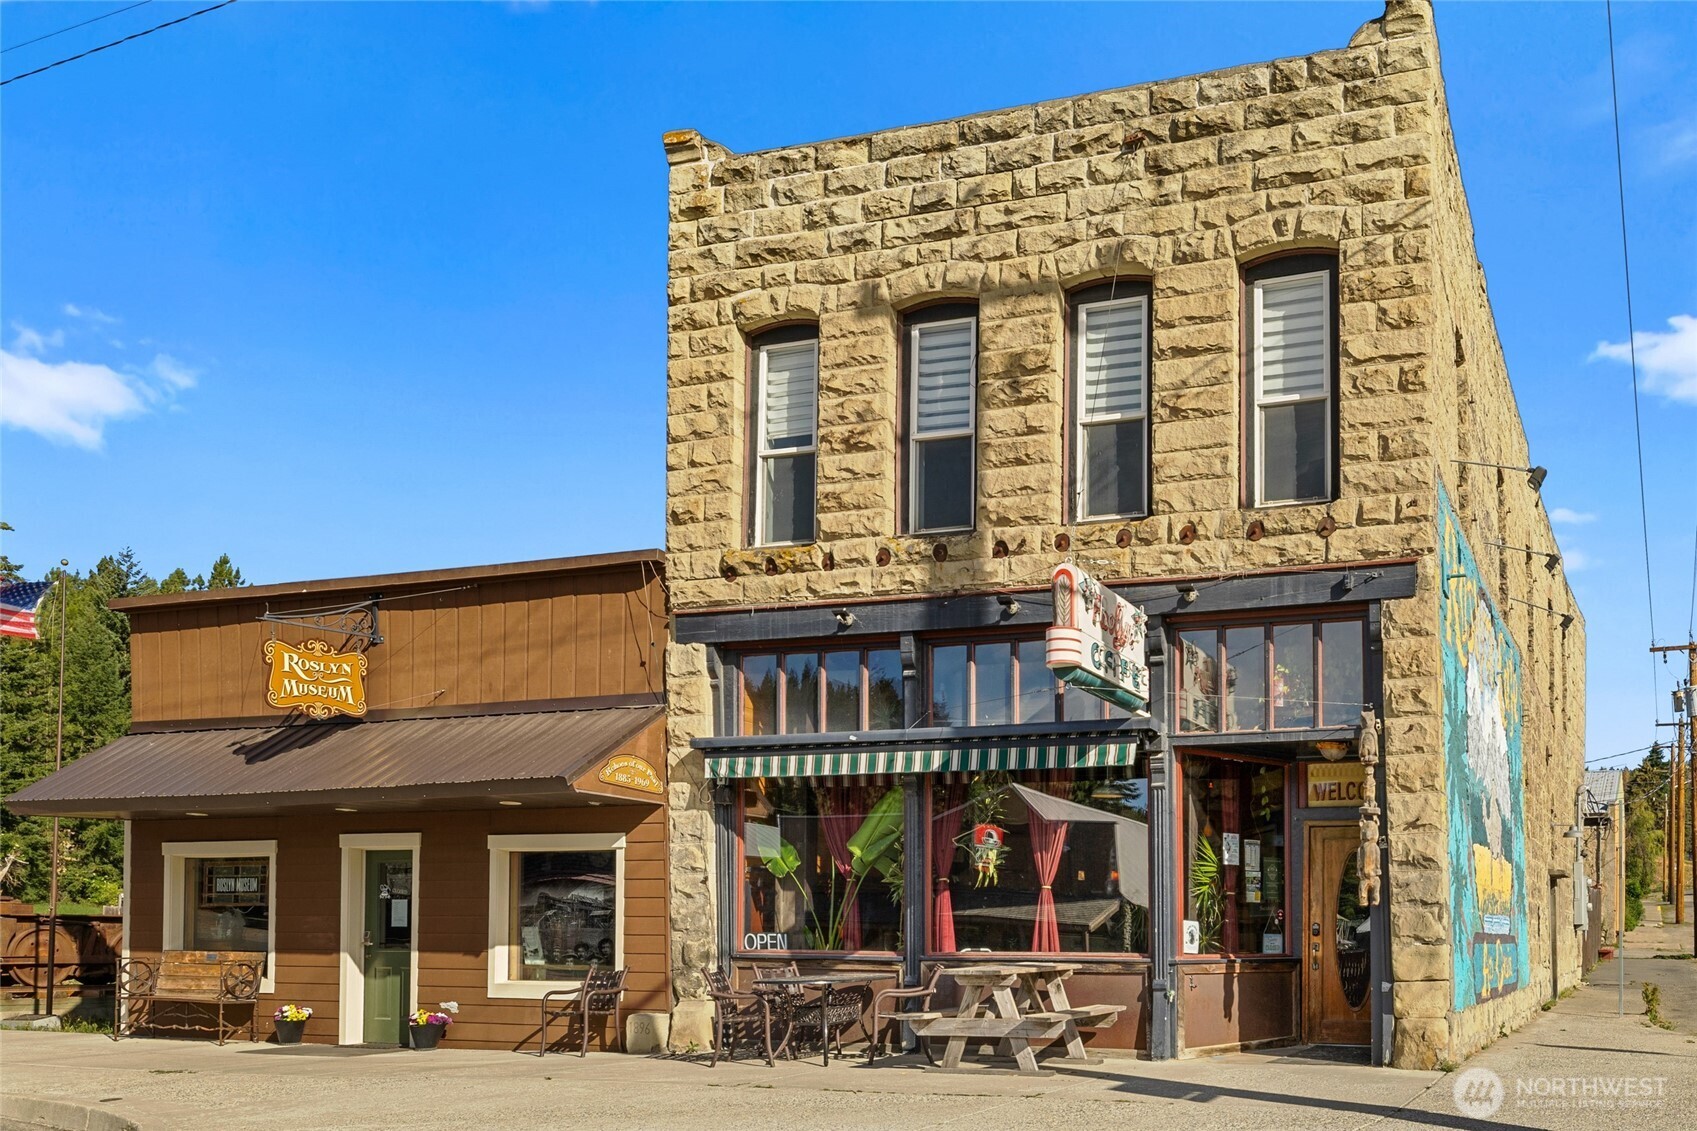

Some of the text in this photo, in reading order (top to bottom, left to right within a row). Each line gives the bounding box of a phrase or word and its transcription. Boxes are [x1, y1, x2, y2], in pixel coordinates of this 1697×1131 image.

[636, 764, 646, 772] our
[216, 877, 258, 892] ROSLYN MUSEUM
[744, 933, 788, 950] OPEN
